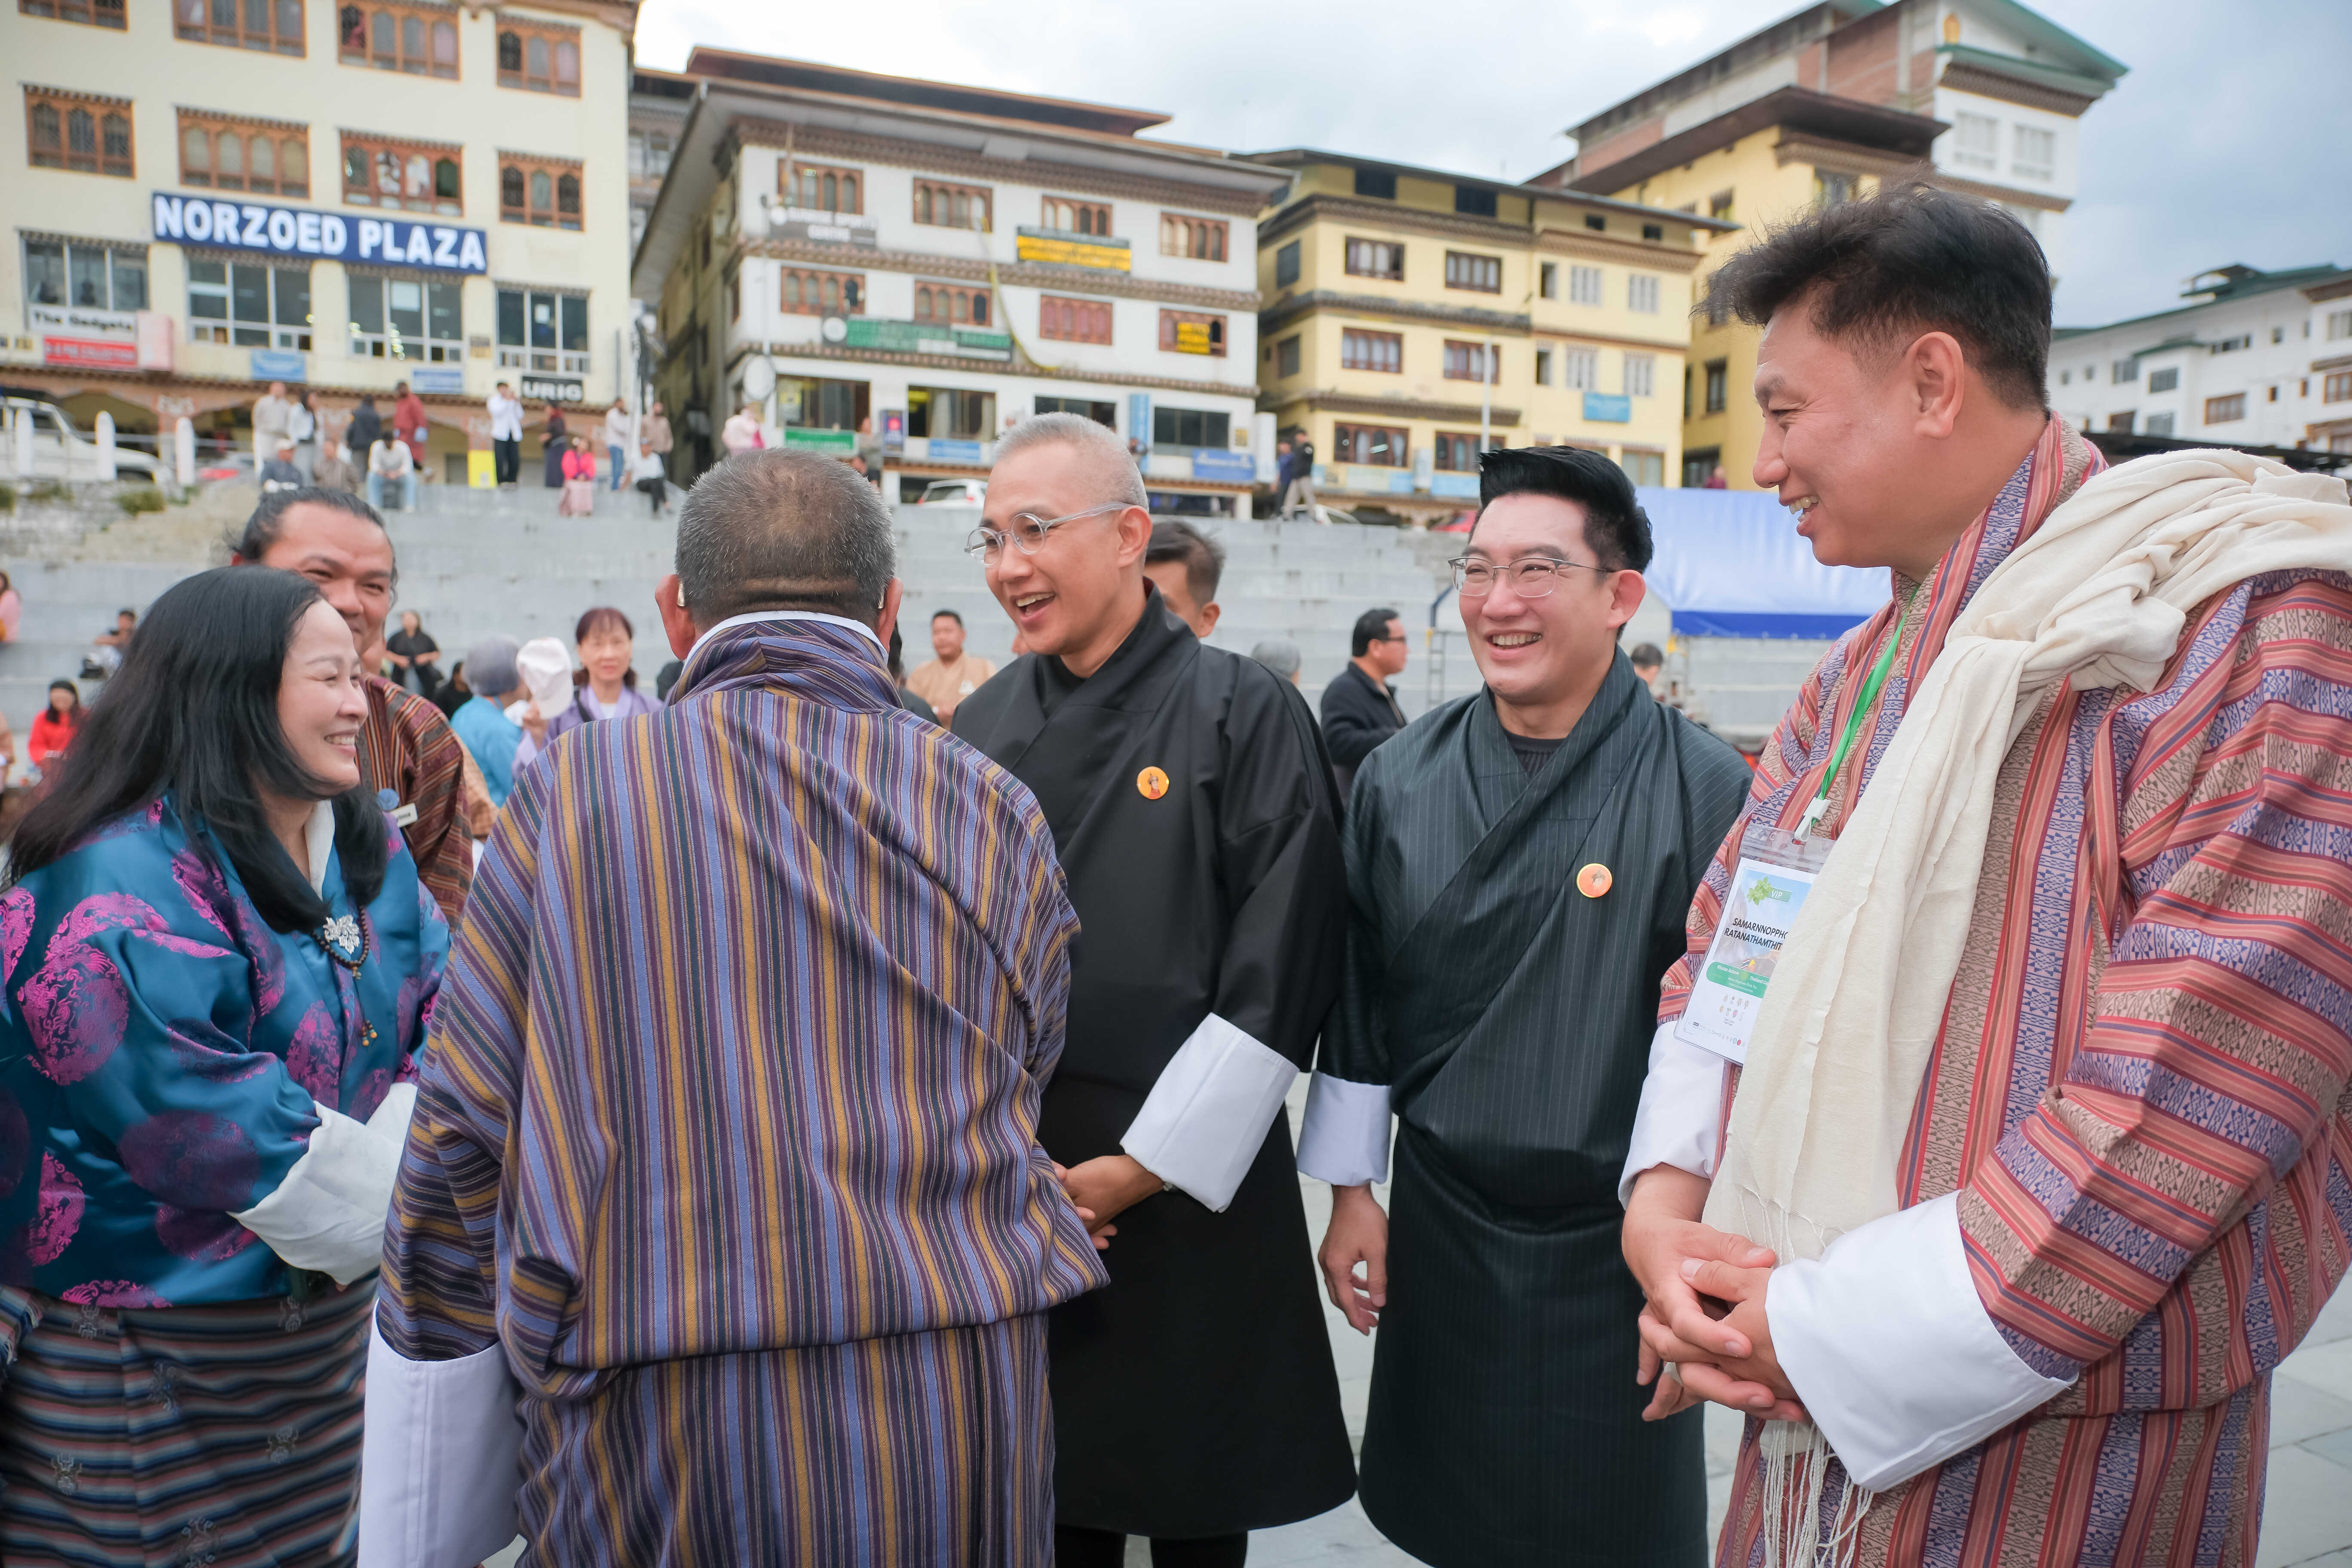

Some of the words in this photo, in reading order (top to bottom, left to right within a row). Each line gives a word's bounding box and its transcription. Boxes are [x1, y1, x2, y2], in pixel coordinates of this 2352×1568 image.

[155, 196, 347, 255] NORZOED
[358, 219, 487, 271] PLAZA
[1771, 890, 1782, 899] VIP
